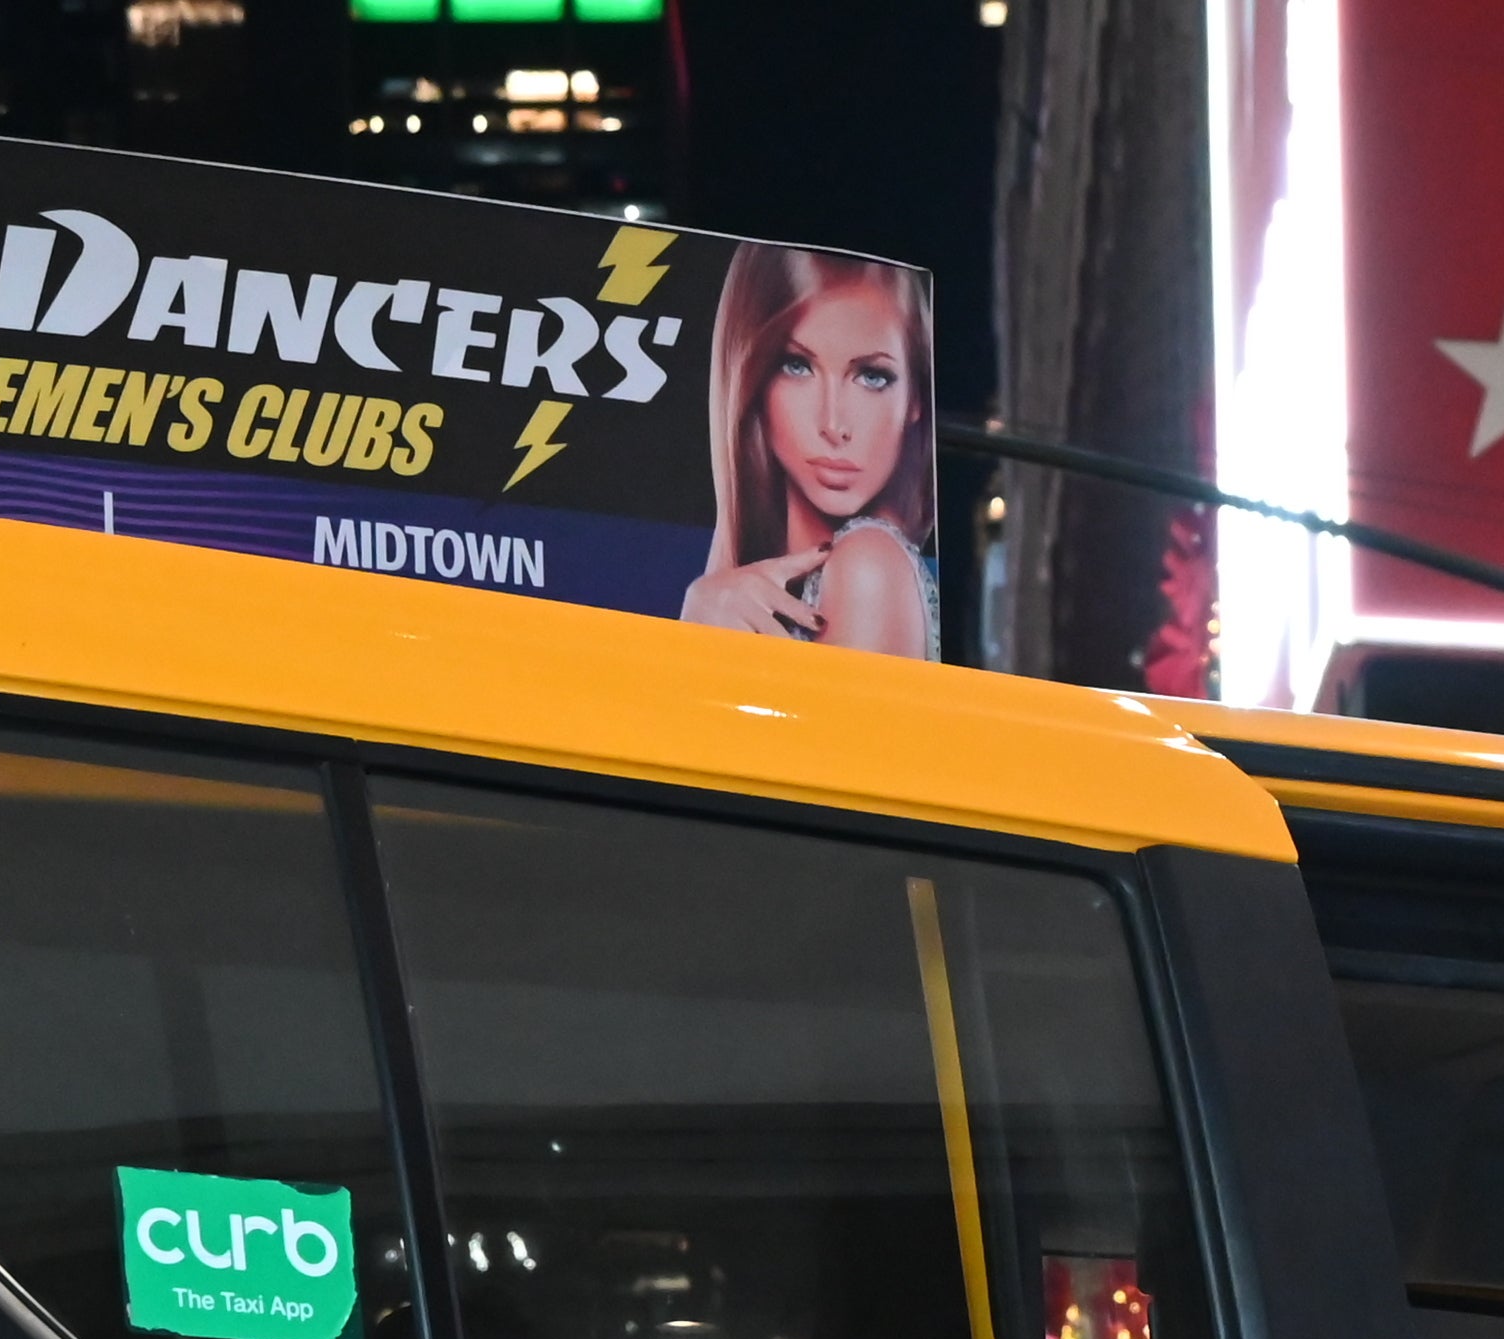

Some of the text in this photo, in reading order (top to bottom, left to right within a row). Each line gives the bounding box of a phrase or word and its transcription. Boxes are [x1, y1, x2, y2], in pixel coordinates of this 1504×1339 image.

[225, 382, 445, 478] CLUBS
[311, 515, 547, 590] MIDTOWN
[136, 1206, 339, 1278] curb
[172, 1286, 315, 1325] The Taxi App
